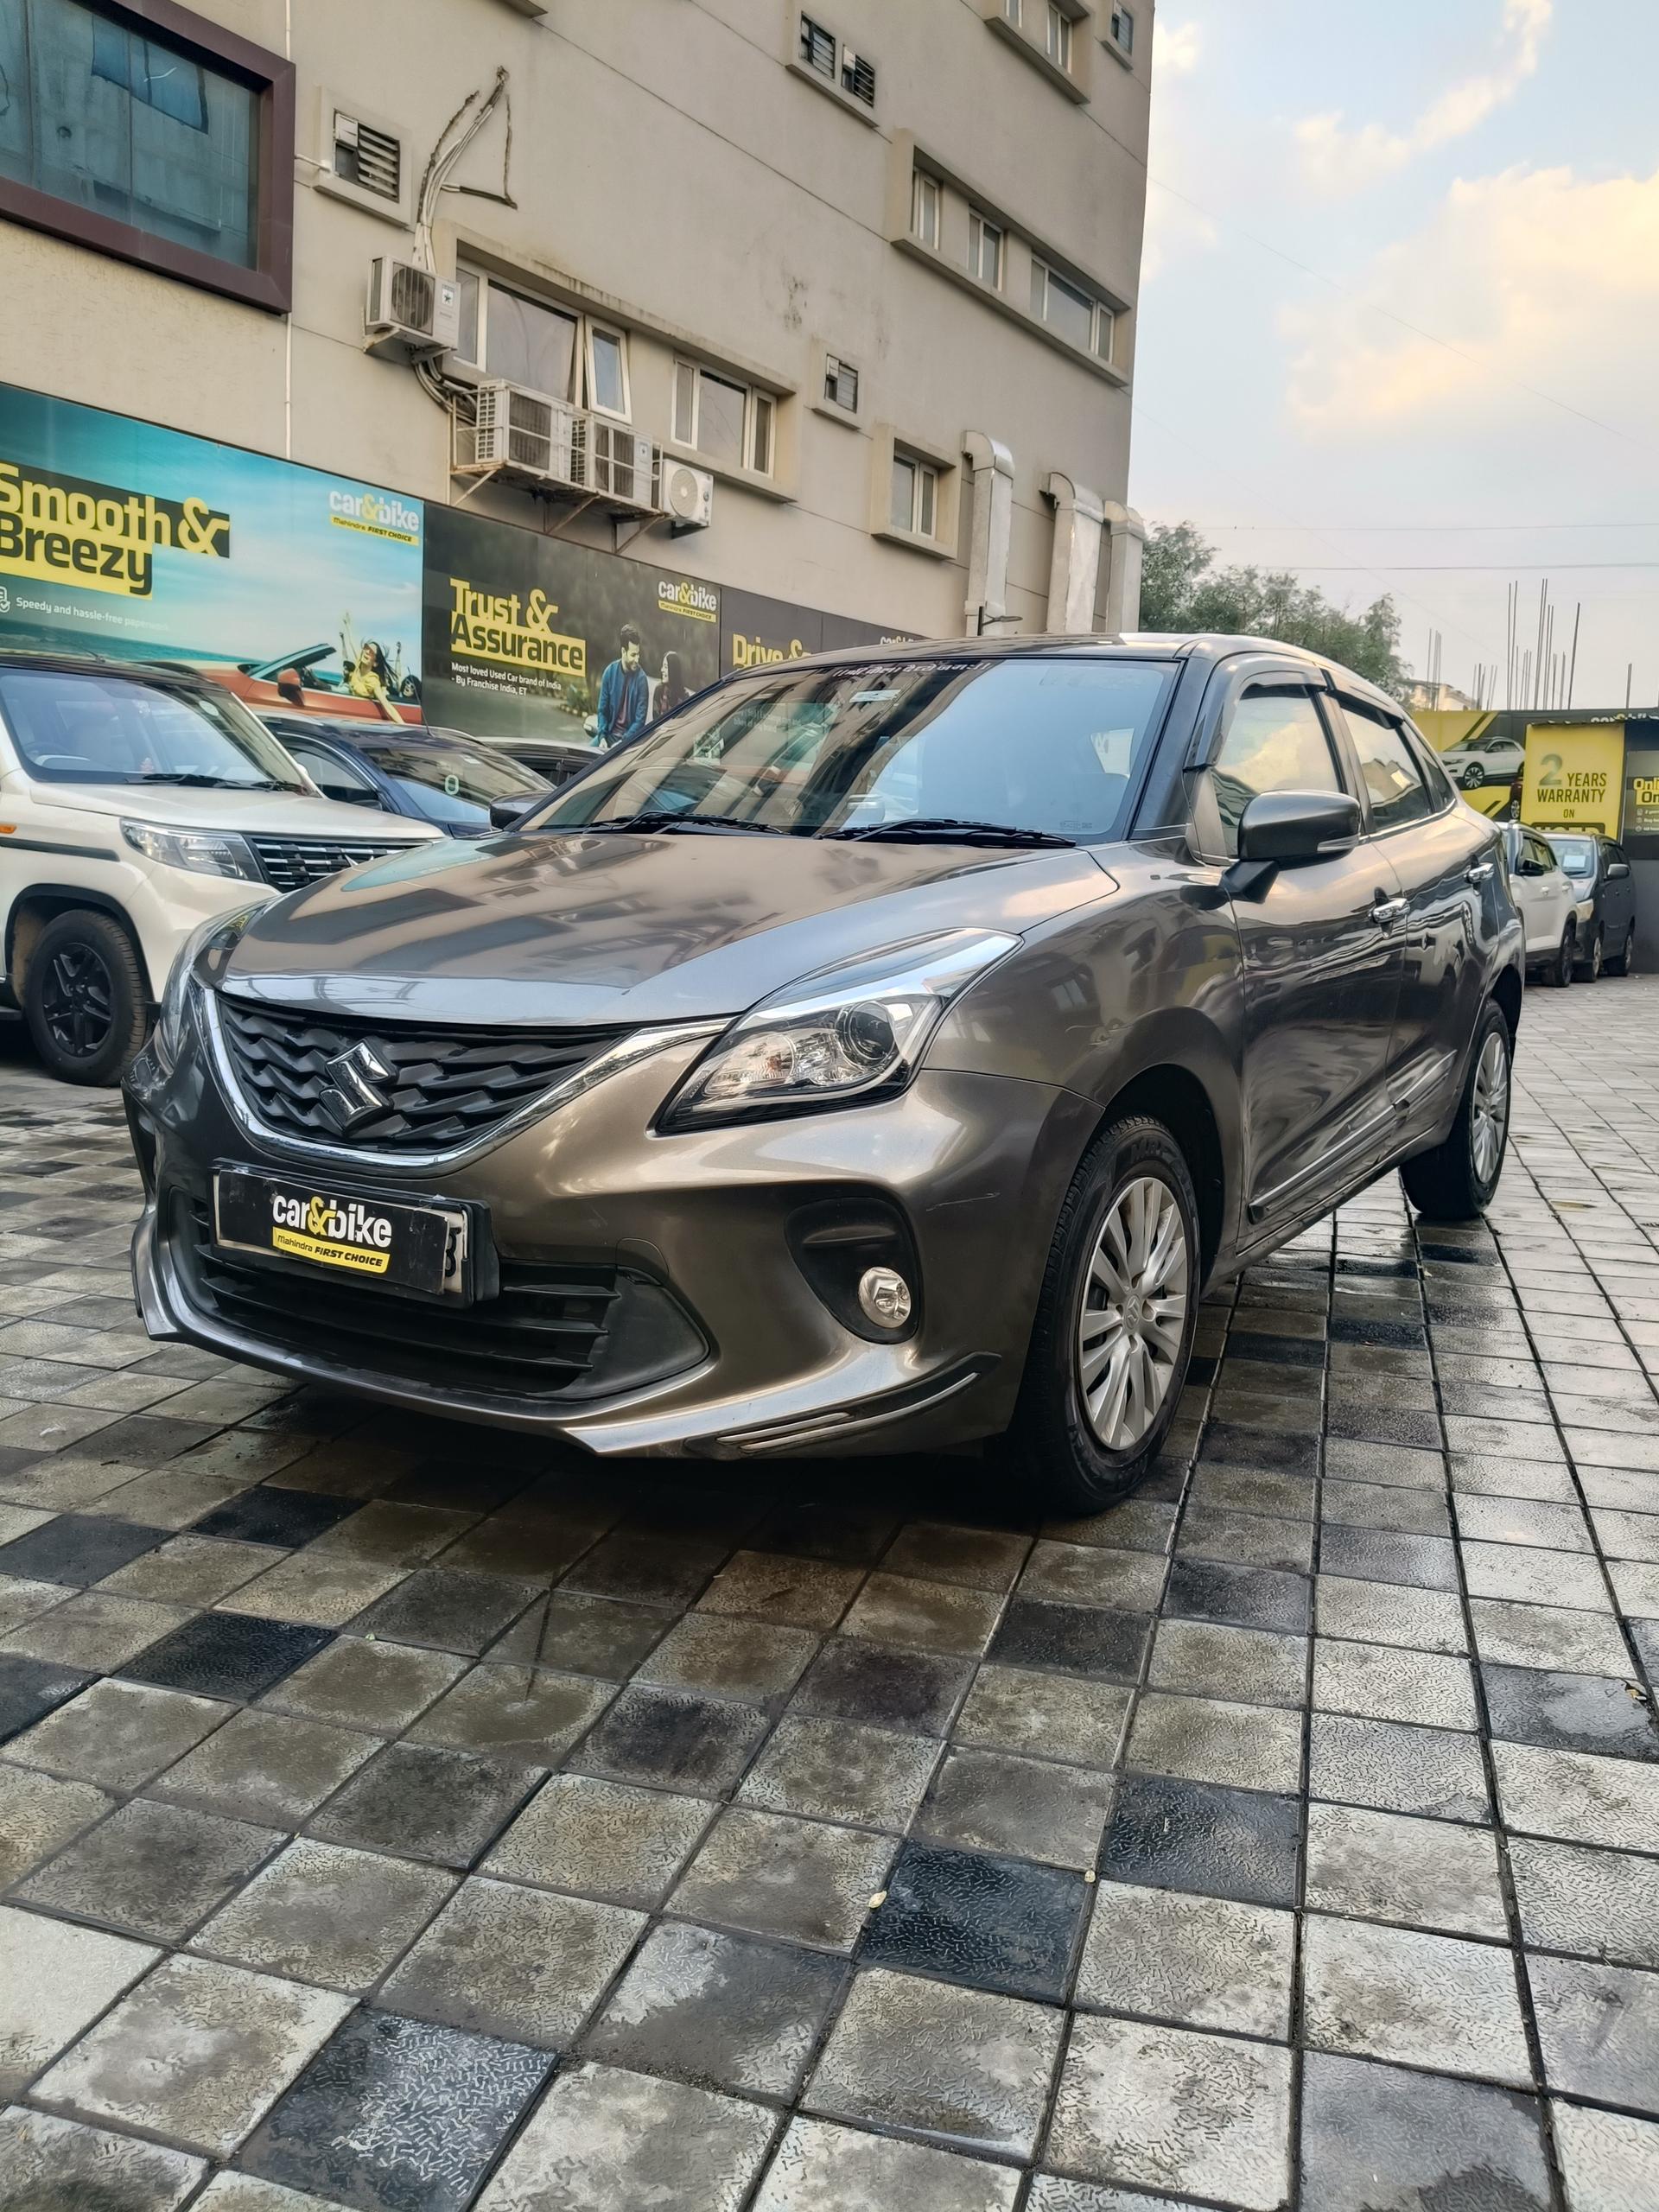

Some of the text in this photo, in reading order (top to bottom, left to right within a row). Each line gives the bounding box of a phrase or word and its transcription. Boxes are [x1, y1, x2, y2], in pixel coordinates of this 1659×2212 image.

[0, 463, 230, 556] Smooth &
[329, 491, 420, 531] car&bike
[367, 526, 388, 536] FIRST
[388, 531, 412, 542] CHOICE
[0, 512, 153, 596] Breezy
[16, 596, 52, 614] Speedy
[54, 605, 71, 616] and
[73, 607, 124, 625] hassle-free
[450, 578, 559, 632] Trust &
[658, 581, 716, 611] car&bike
[450, 613, 584, 671] Assurance
[451, 662, 562, 690] Most loved Used Car brand of India
[455, 675, 466, 686] By
[467, 677, 499, 691] Franchise
[499, 683, 518, 695] India,
[518, 687, 527, 696] ET
[1539, 753, 1607, 787] 2 YEARS
[1537, 788, 1605, 803] WARRANTY
[1563, 809, 1574, 818] ON
[272, 1195, 392, 1248] car&bike
[277, 1235, 383, 1267] Mahindra FIRST CHOICE
